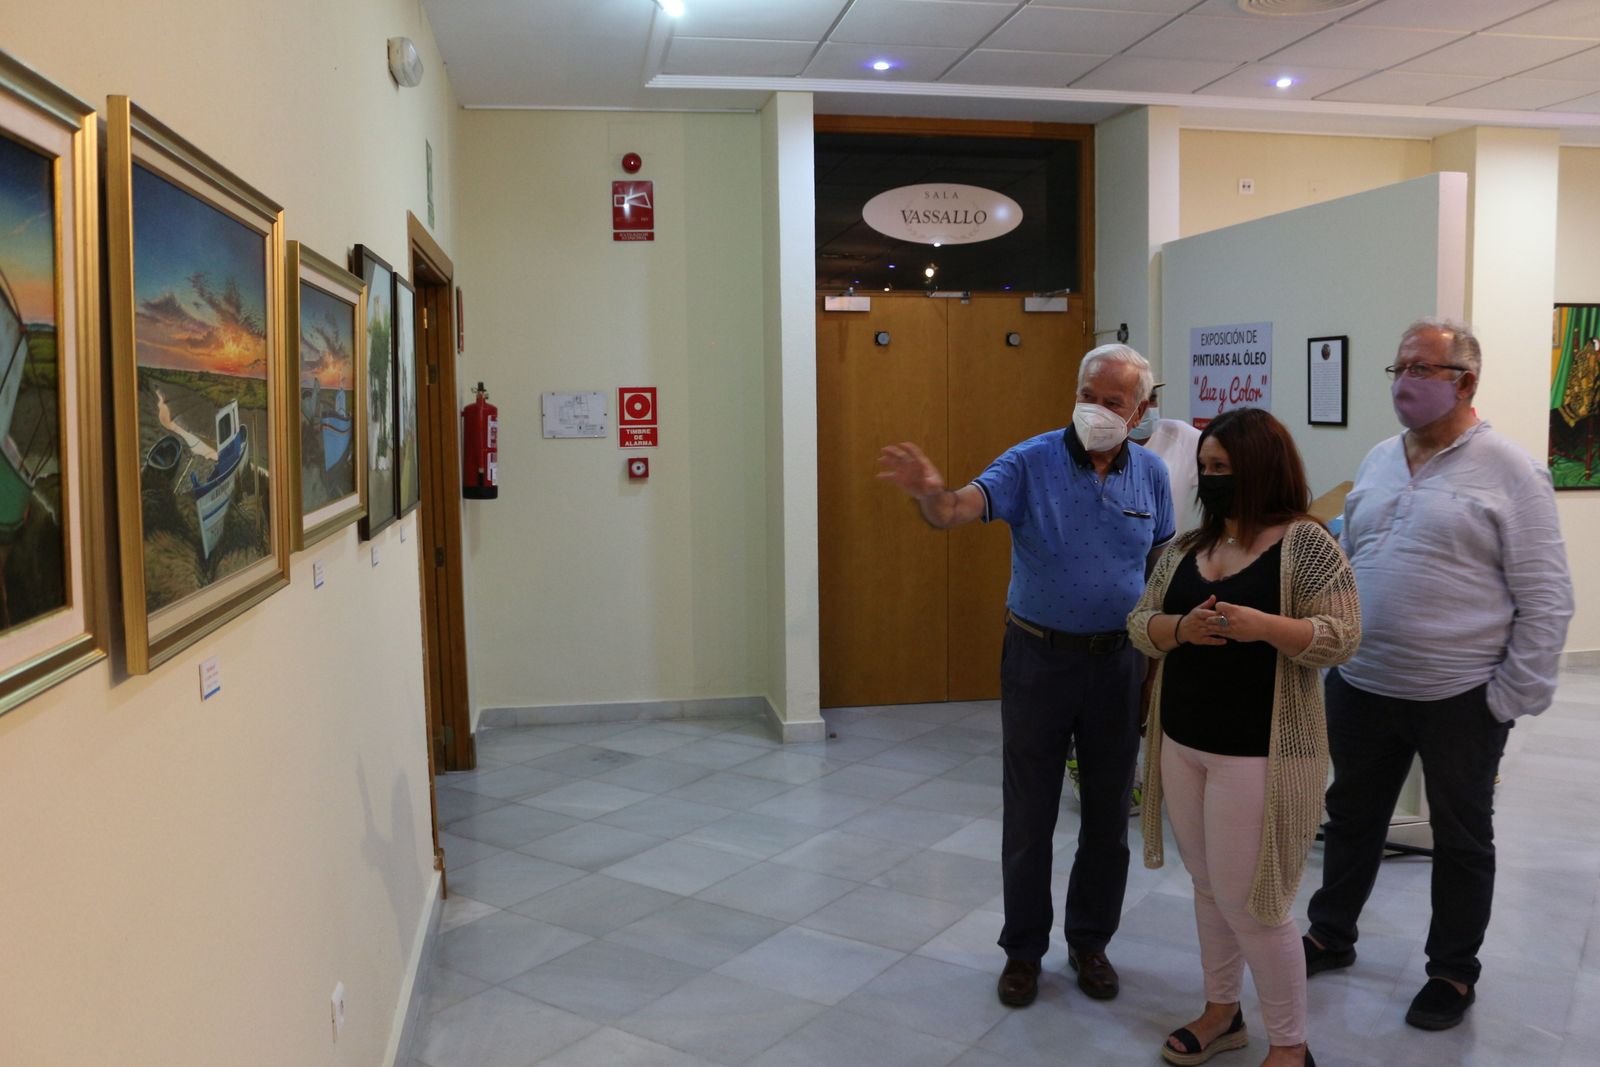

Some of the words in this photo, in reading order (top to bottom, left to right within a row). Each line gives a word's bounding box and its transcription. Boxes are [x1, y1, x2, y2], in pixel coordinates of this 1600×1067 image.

[924, 191, 959, 200] SALA
[901, 209, 987, 225] VASSALLO
[1201, 329, 1244, 346] EXPOSICIÓN
[1246, 329, 1258, 344] DE
[1193, 353, 1231, 367] PINTURAS
[1231, 353, 1242, 366] AL
[1243, 349, 1266, 366] ÓLEO
[1217, 387, 1227, 414] y
